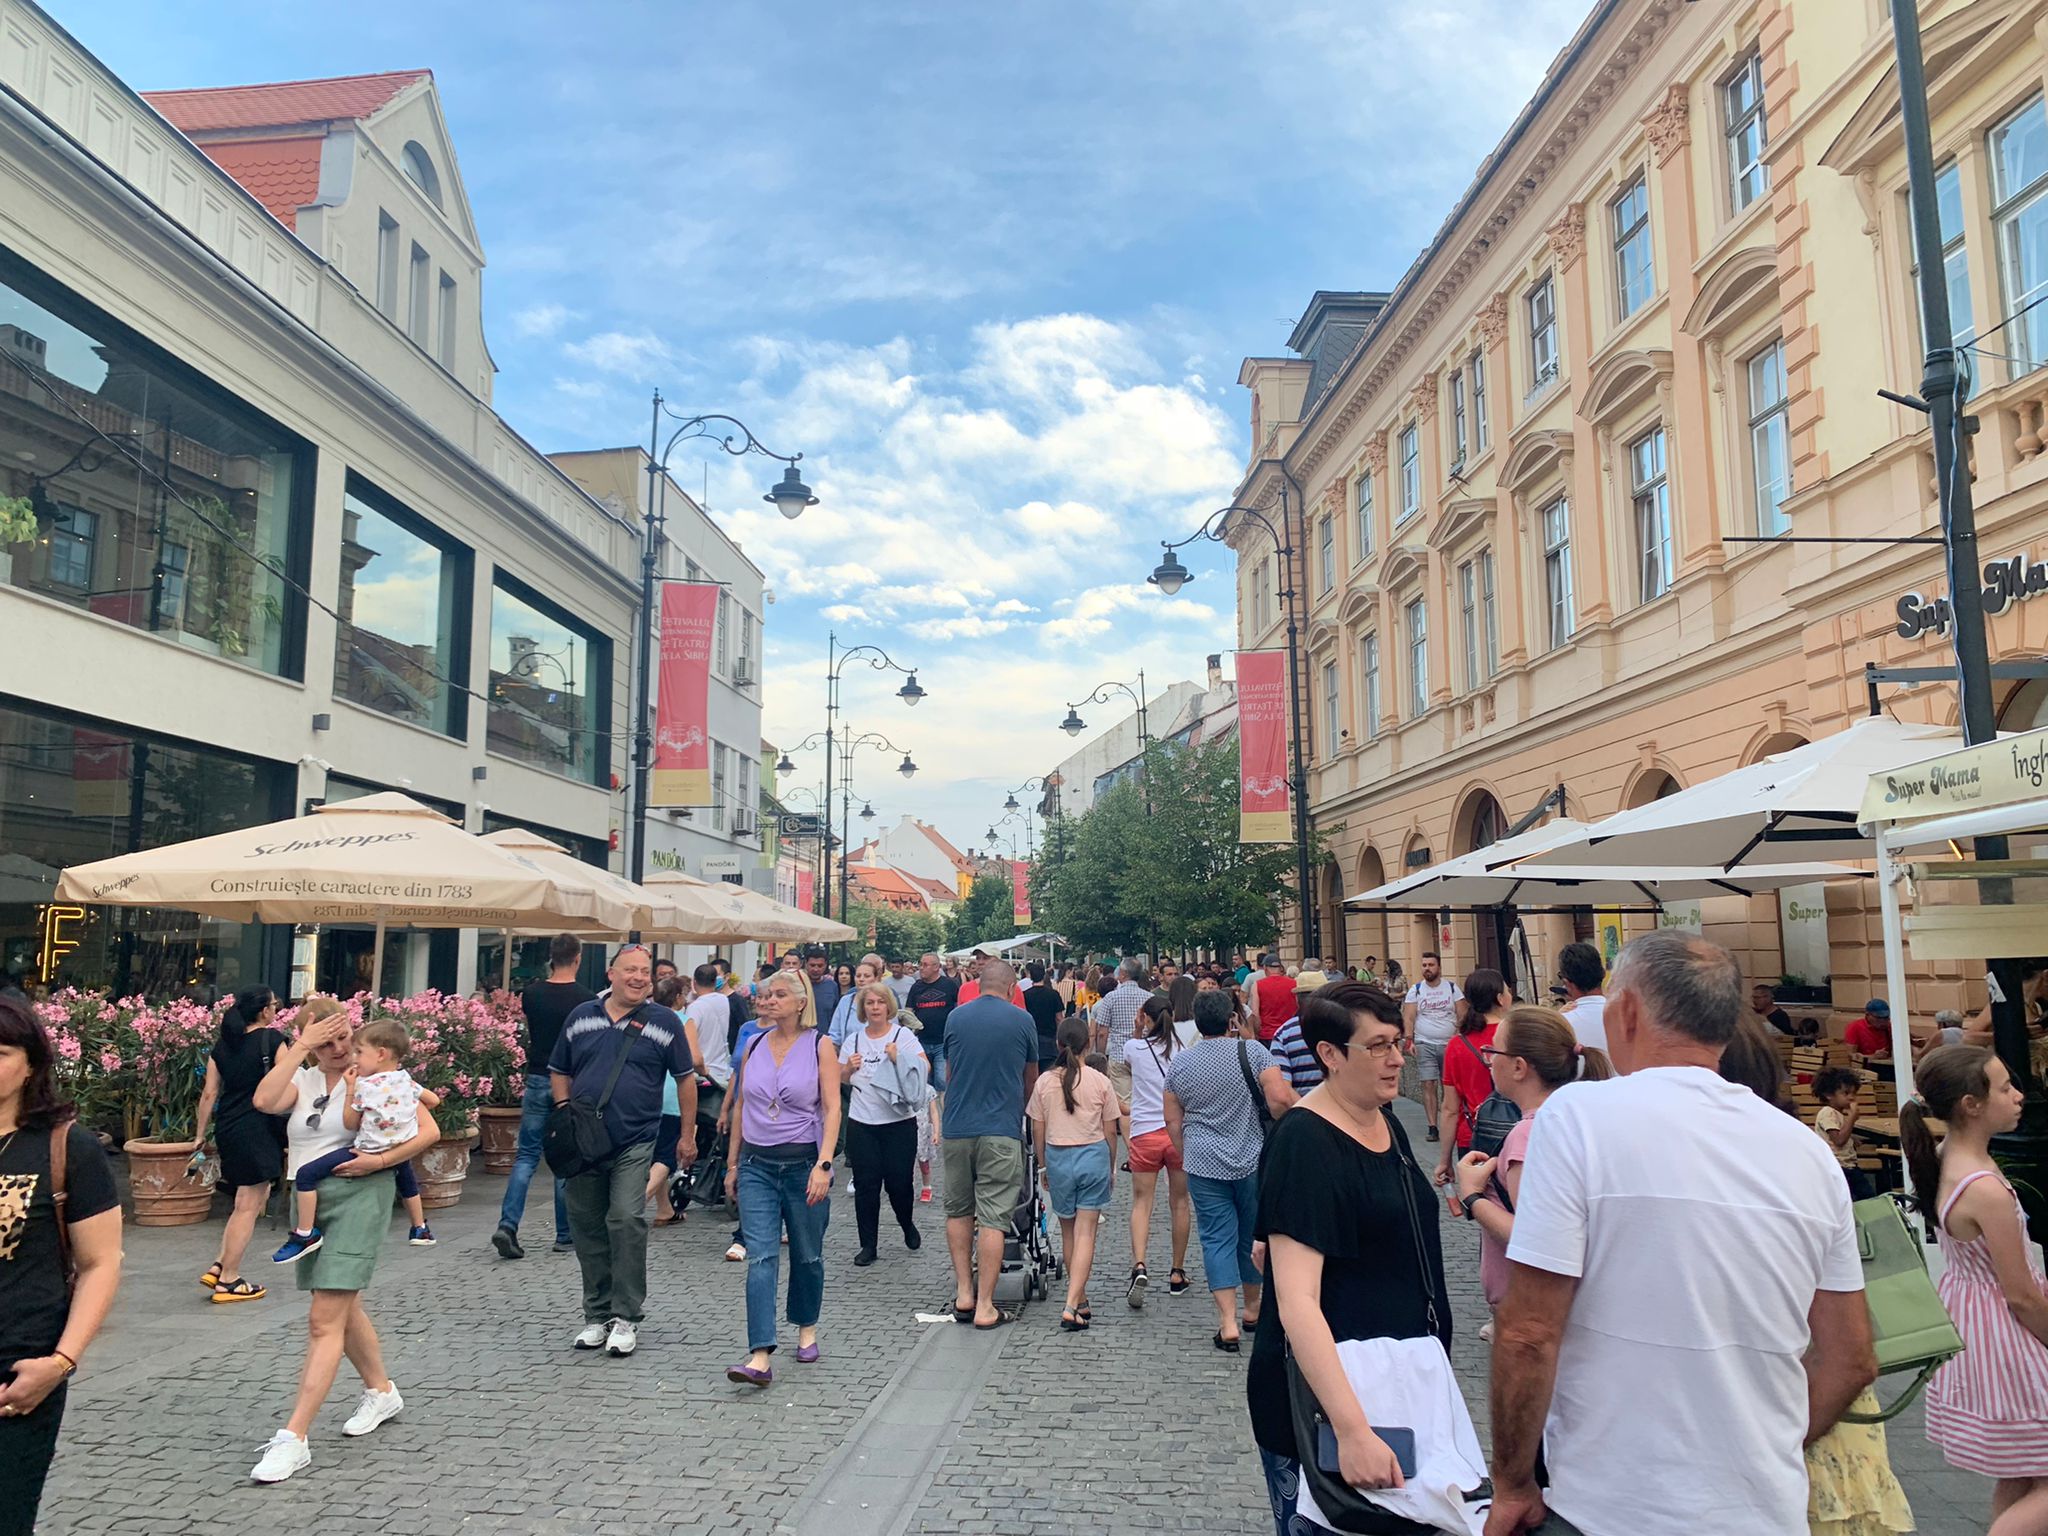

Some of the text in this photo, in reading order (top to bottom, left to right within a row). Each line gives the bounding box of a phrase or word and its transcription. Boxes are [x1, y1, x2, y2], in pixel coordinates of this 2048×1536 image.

[1897, 555, 2048, 638] Sup Ma
[671, 637, 709, 649] TEATRU
[1884, 775, 1925, 804] Super
[1929, 766, 1980, 796] Mama
[243, 831, 416, 858] Schweppes
[92, 873, 140, 899] Schweppes
[210, 877, 473, 899] Construiește caractere din 1783
[1662, 909, 1688, 929] Super
[1788, 901, 1825, 924] Super
[916, 1001, 947, 1009] UMBRO
